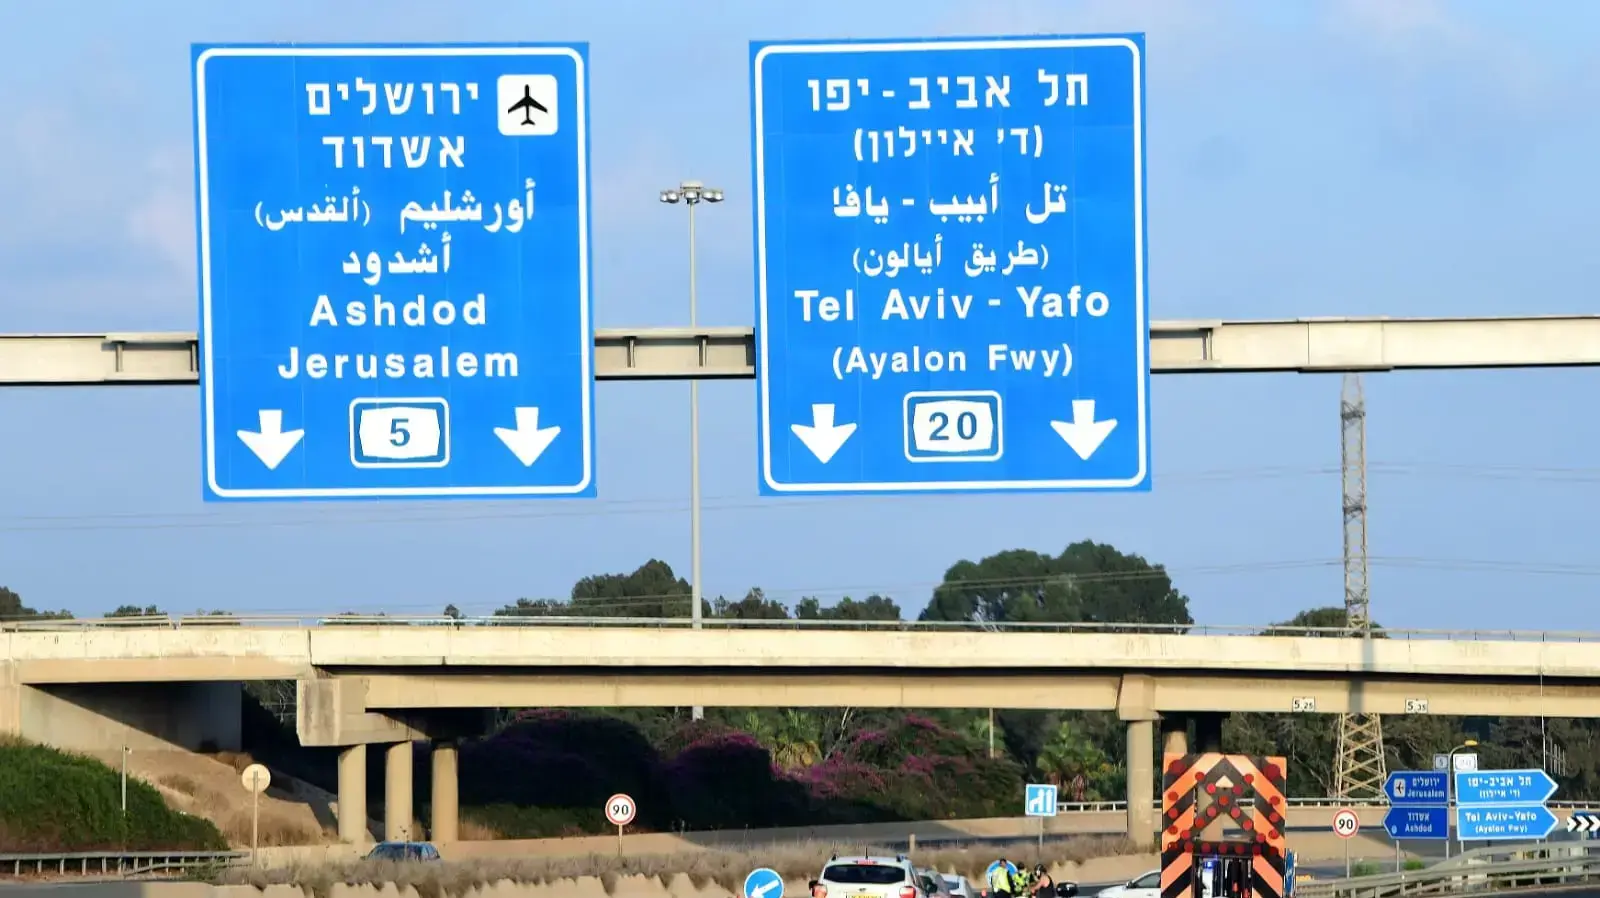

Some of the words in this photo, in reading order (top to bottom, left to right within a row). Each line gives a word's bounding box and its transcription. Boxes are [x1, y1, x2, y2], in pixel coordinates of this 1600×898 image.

[305, 77, 479, 116] ירושלים
[1037, 68, 1089, 107] תל
[322, 135, 465, 169] אשדוד
[854, 126, 974, 163] איילון)
[400, 178, 536, 234] أورشليم
[929, 172, 999, 223] أبيب
[1025, 182, 1068, 225] تل
[342, 231, 452, 286] أشدود
[852, 233, 943, 278] أيالون)
[964, 240, 1049, 278] (طريق
[309, 293, 486, 327] Ashdod
[794, 289, 854, 322] Tel
[881, 287, 973, 320] Aviv
[1016, 285, 1110, 318] Yafo
[277, 345, 518, 379] Jerusalem
[832, 345, 967, 380] (Ayalon
[988, 343, 1073, 377] Fwy)
[390, 418, 411, 447] 5
[928, 411, 978, 441] 20
[1407, 788, 1445, 798] Jerusalem
[1412, 776, 1440, 787] ירושלים
[1518, 775, 1532, 786] תל
[612, 804, 630, 816] 90
[1338, 818, 1354, 830] 90
[1407, 811, 1430, 822] אשדוד
[1465, 811, 1481, 822] Tel
[1404, 823, 1433, 833] Ashdod
[1475, 824, 1505, 834] (Ayalon
[1508, 823, 1528, 833] Fwy)
